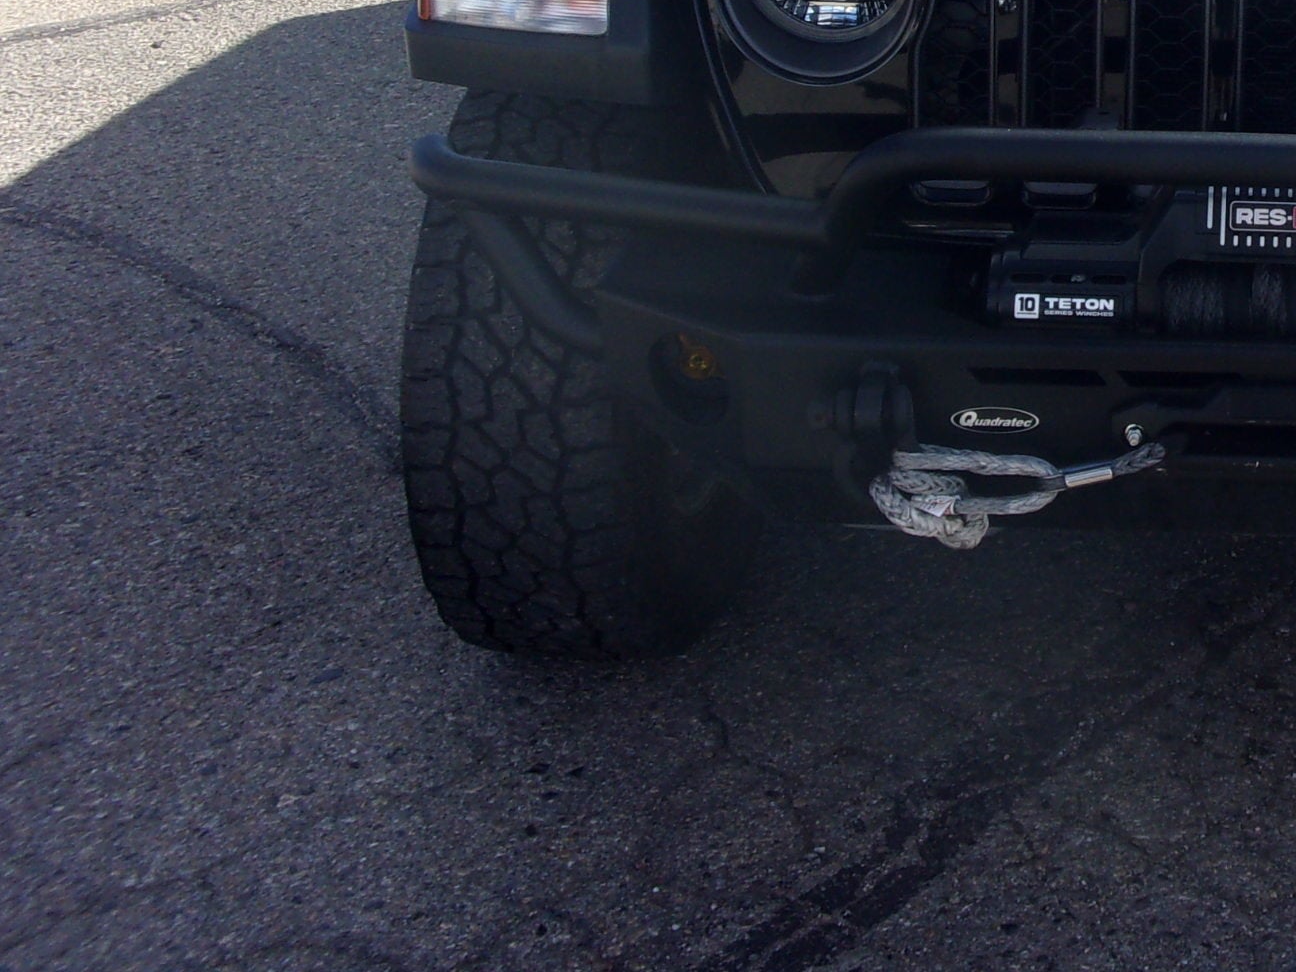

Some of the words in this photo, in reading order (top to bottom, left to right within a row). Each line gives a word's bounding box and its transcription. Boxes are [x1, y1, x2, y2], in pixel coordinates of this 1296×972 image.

[1018, 296, 1037, 312] 10
[1044, 297, 1115, 311] TETON
[1044, 309, 1074, 317] SERIES
[959, 411, 1034, 427] Quadratec
